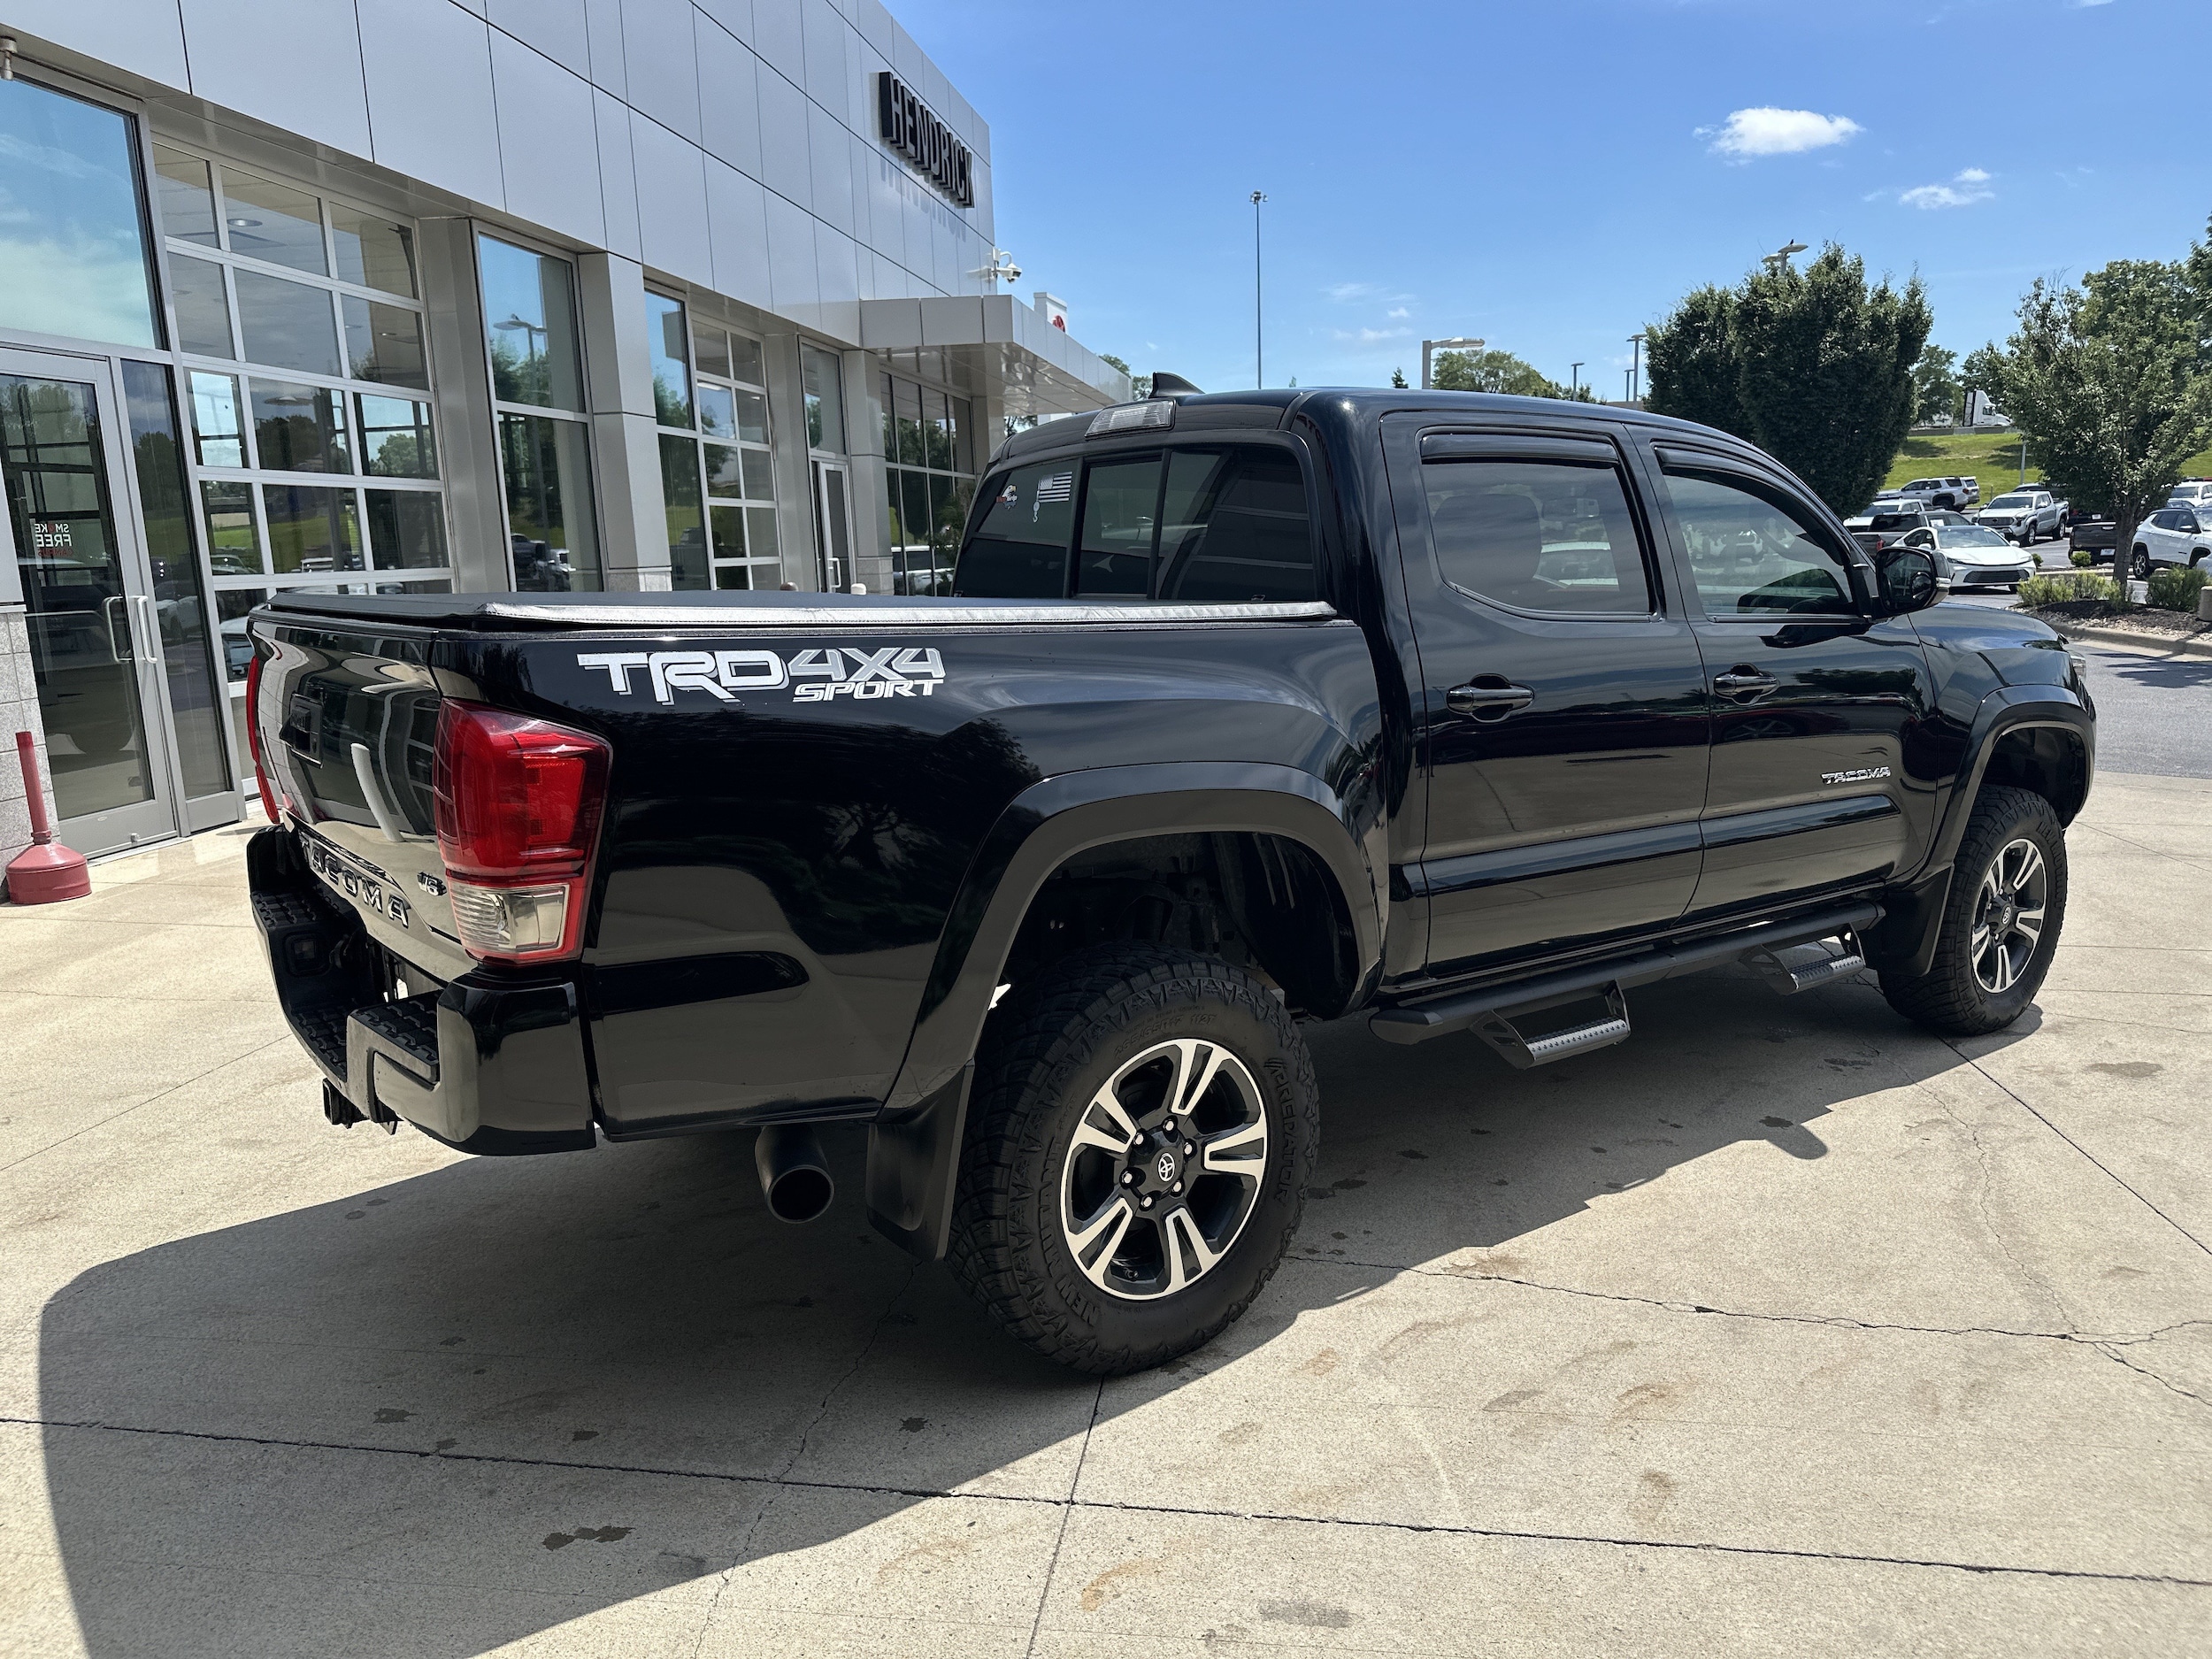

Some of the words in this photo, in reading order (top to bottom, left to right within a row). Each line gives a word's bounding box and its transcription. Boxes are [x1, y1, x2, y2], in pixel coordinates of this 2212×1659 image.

[879, 72, 974, 208] HENDRICK
[577, 649, 790, 705] TRD
[787, 648, 946, 682] 4X4
[792, 679, 944, 703] SPORT
[1821, 766, 1891, 785] TACOMA
[299, 831, 410, 929] TACOMA
[1039, 1134, 1064, 1279] MUTANT
[1056, 1275, 1102, 1327] NEW
